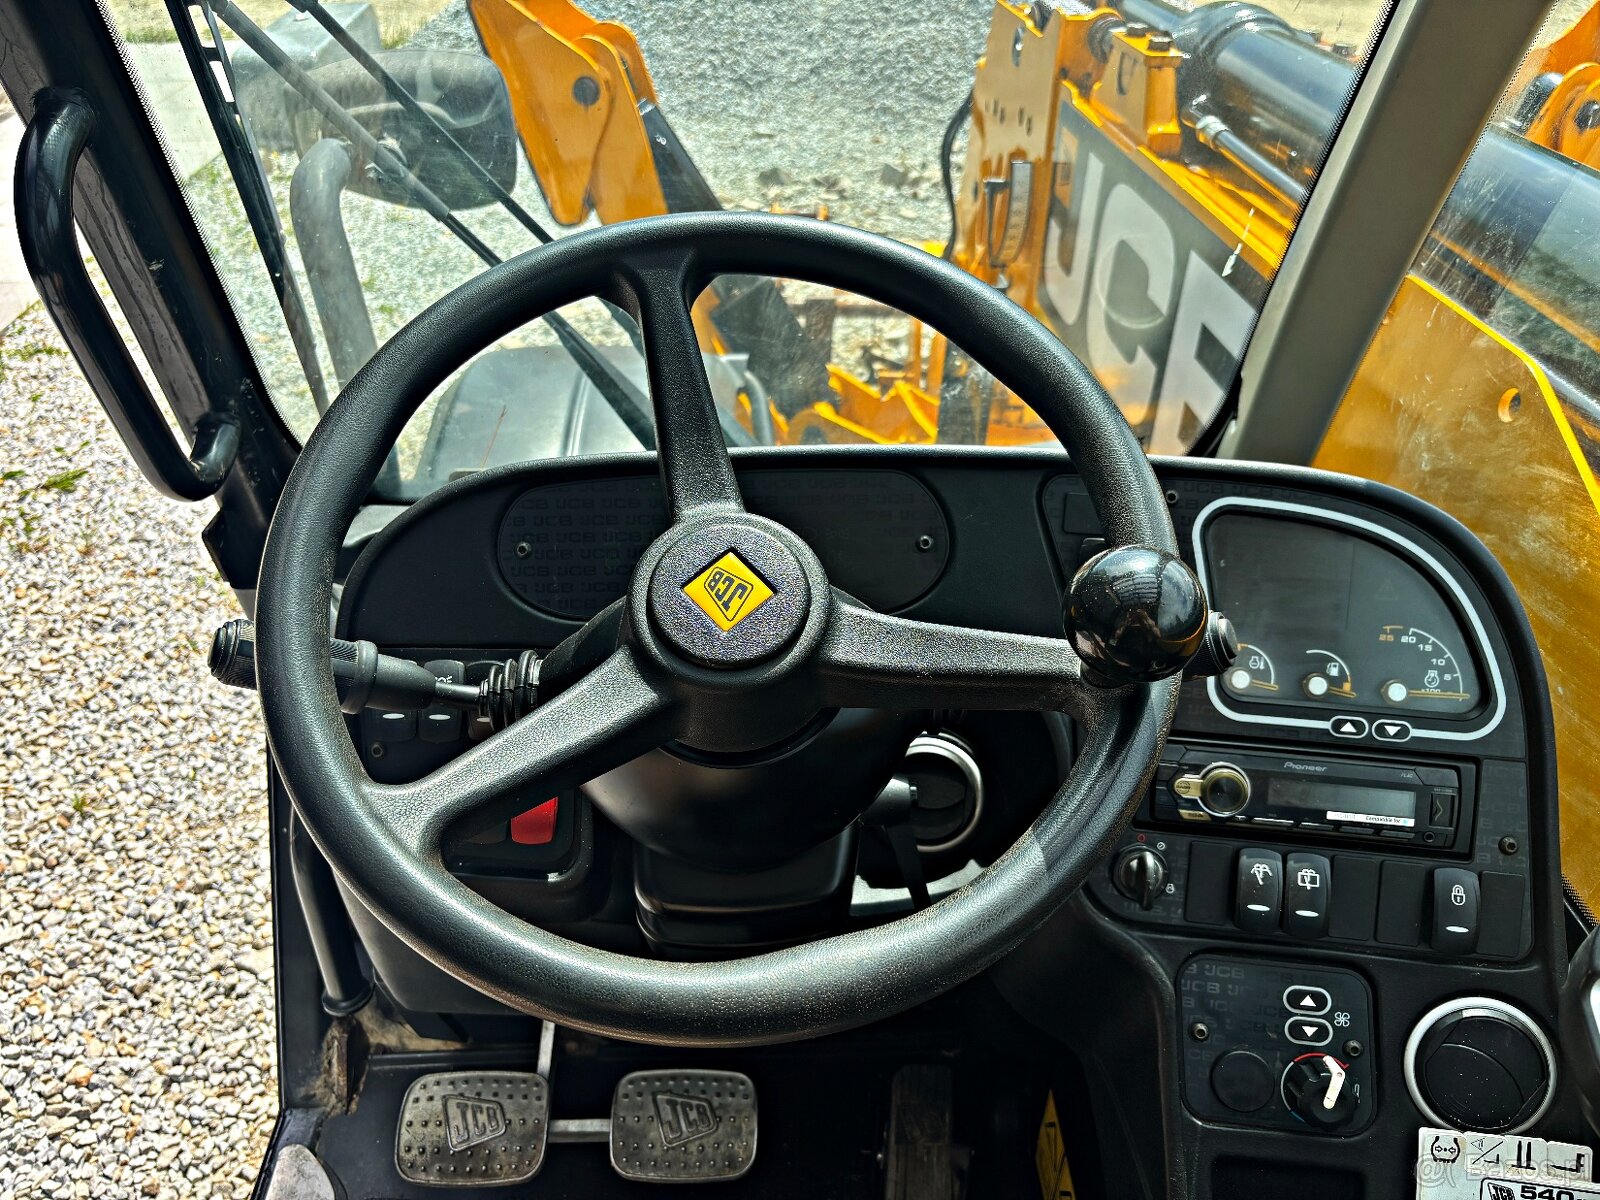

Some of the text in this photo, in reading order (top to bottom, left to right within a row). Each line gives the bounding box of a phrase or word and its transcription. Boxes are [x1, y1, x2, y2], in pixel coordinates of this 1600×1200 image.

[708, 570, 748, 612] JCB
[1379, 634, 1416, 643] 25 20
[1431, 658, 1445, 666] 10
[1284, 761, 1327, 773] Pioneer
[1204, 964, 1245, 977] JCB
[452, 1101, 500, 1145] JCB
[663, 1099, 711, 1140] JCB
[1520, 1185, 1575, 1200] 540
